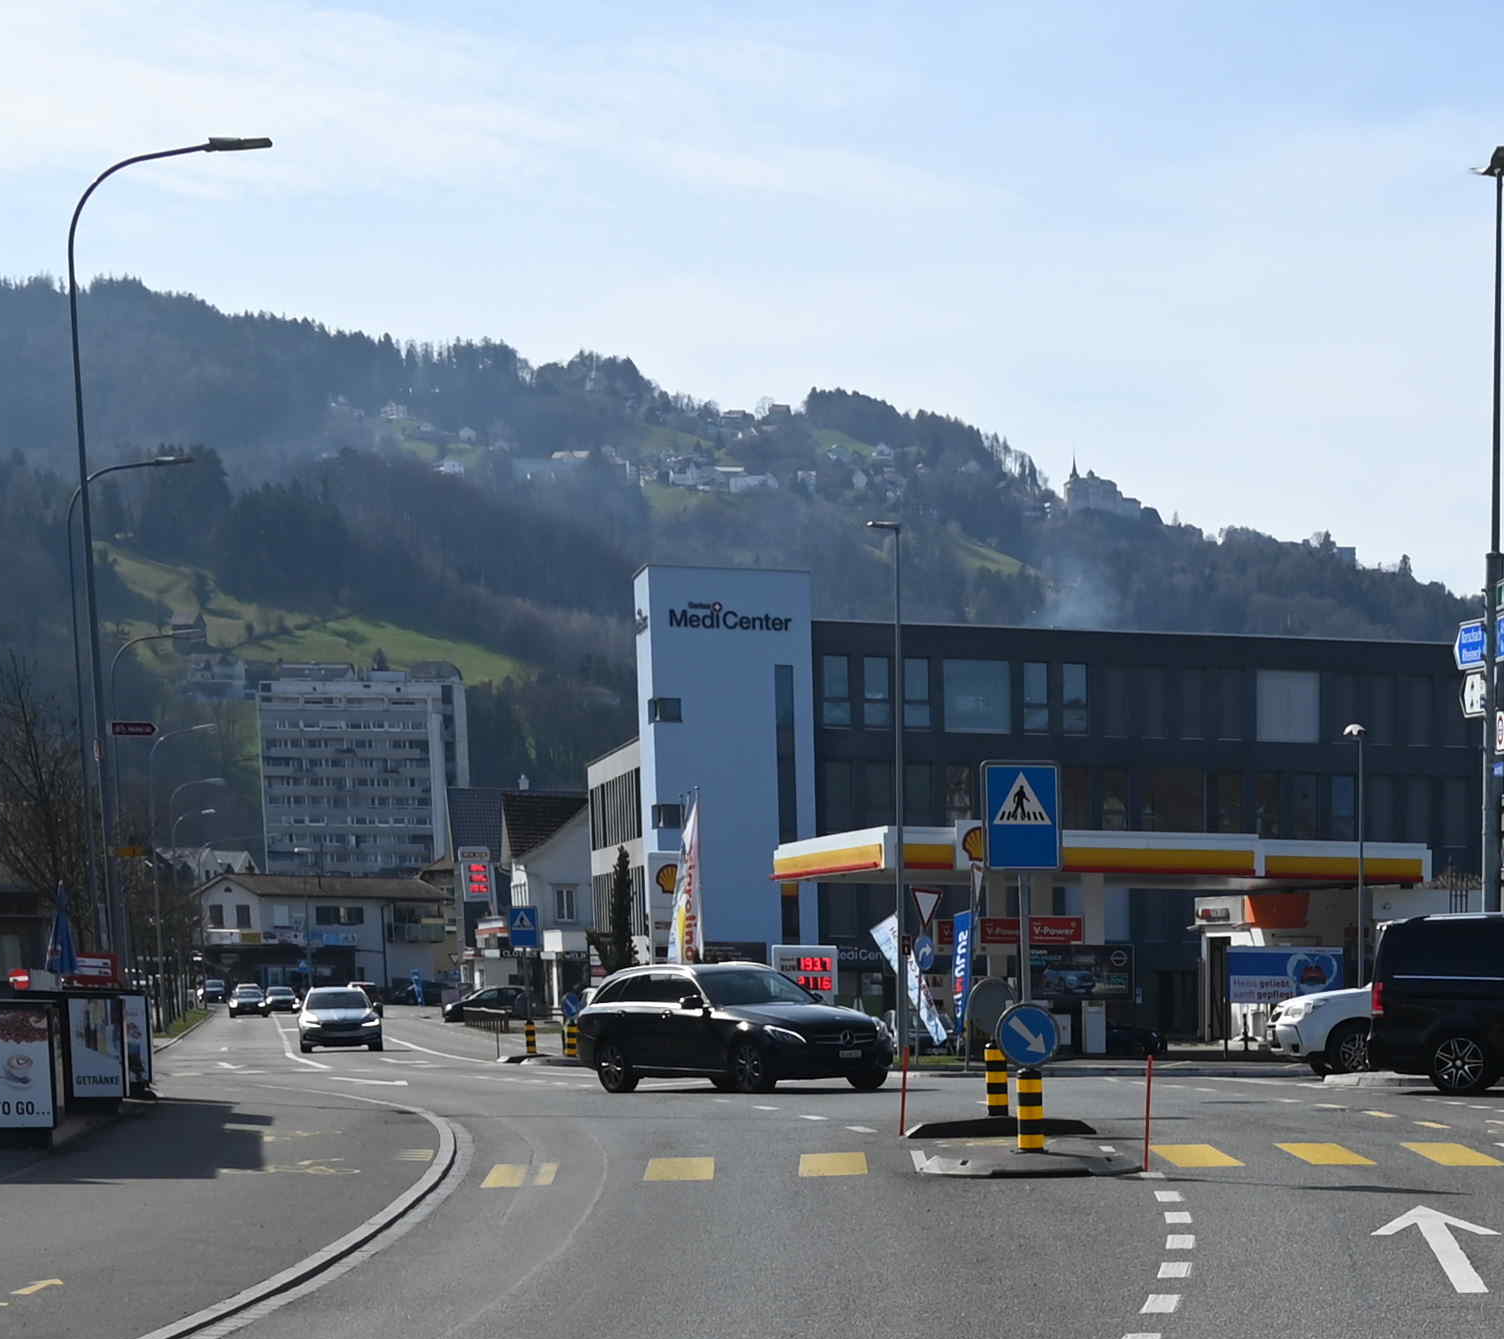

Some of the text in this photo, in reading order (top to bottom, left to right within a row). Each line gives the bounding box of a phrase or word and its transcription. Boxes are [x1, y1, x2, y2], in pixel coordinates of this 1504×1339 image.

[669, 604, 792, 631] MediCenter
[1033, 925, 1074, 936] V-Power
[76, 1074, 120, 1086] GETRÄNKE
[15, 1101, 50, 1116] GO...
